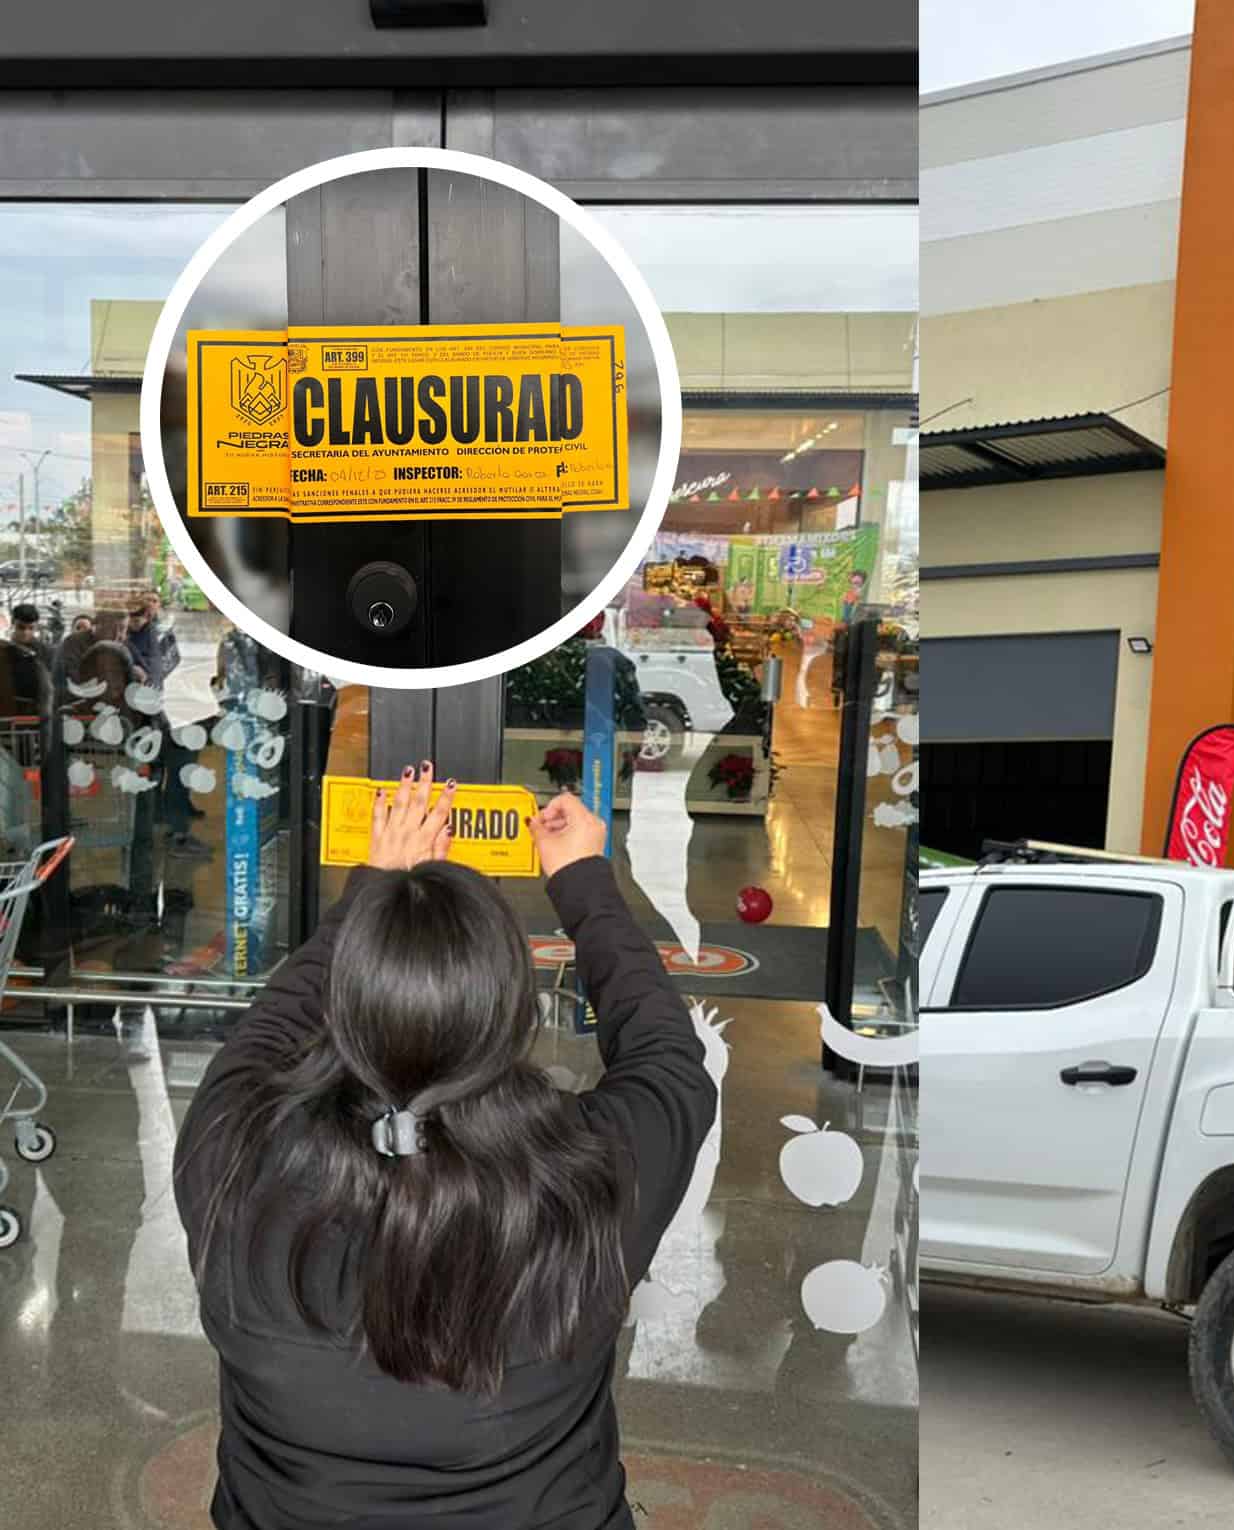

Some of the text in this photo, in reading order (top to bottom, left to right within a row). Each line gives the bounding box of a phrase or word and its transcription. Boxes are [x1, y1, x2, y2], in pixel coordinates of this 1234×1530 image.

[325, 351, 344, 362] ART.
[345, 351, 364, 362] 399
[351, 449, 370, 458] DEL
[372, 448, 449, 458] AYUNTAMIENTO
[512, 446, 526, 455] DE
[564, 443, 587, 452] CIVIL
[393, 466, 463, 481] INSPECTOR:
[207, 485, 227, 496] ART.
[229, 485, 248, 496] 215
[1179, 765, 1229, 867] Cola
[234, 852, 248, 918] GRATIS!
